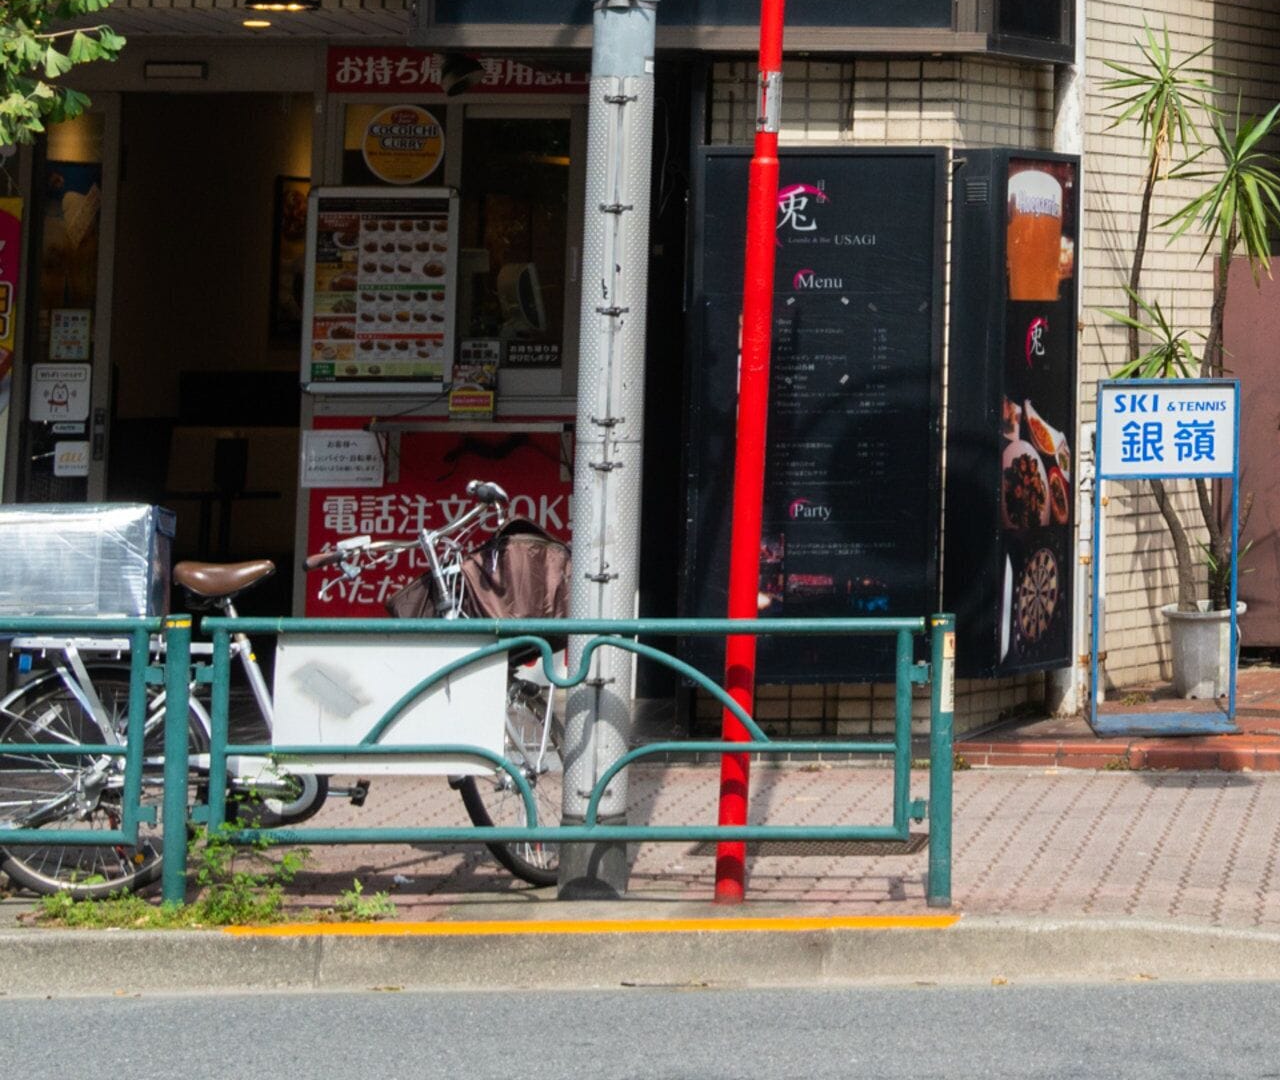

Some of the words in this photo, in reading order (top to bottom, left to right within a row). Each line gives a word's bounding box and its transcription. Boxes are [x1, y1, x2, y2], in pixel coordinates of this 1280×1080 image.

[834, 234, 876, 246] USAGI
[799, 274, 843, 289] Menu
[1114, 393, 1159, 413] SKI
[1167, 401, 1176, 412] &
[1178, 401, 1227, 412] TENNIS
[1121, 419, 1216, 462] 銀嶺
[794, 503, 832, 521] Party
